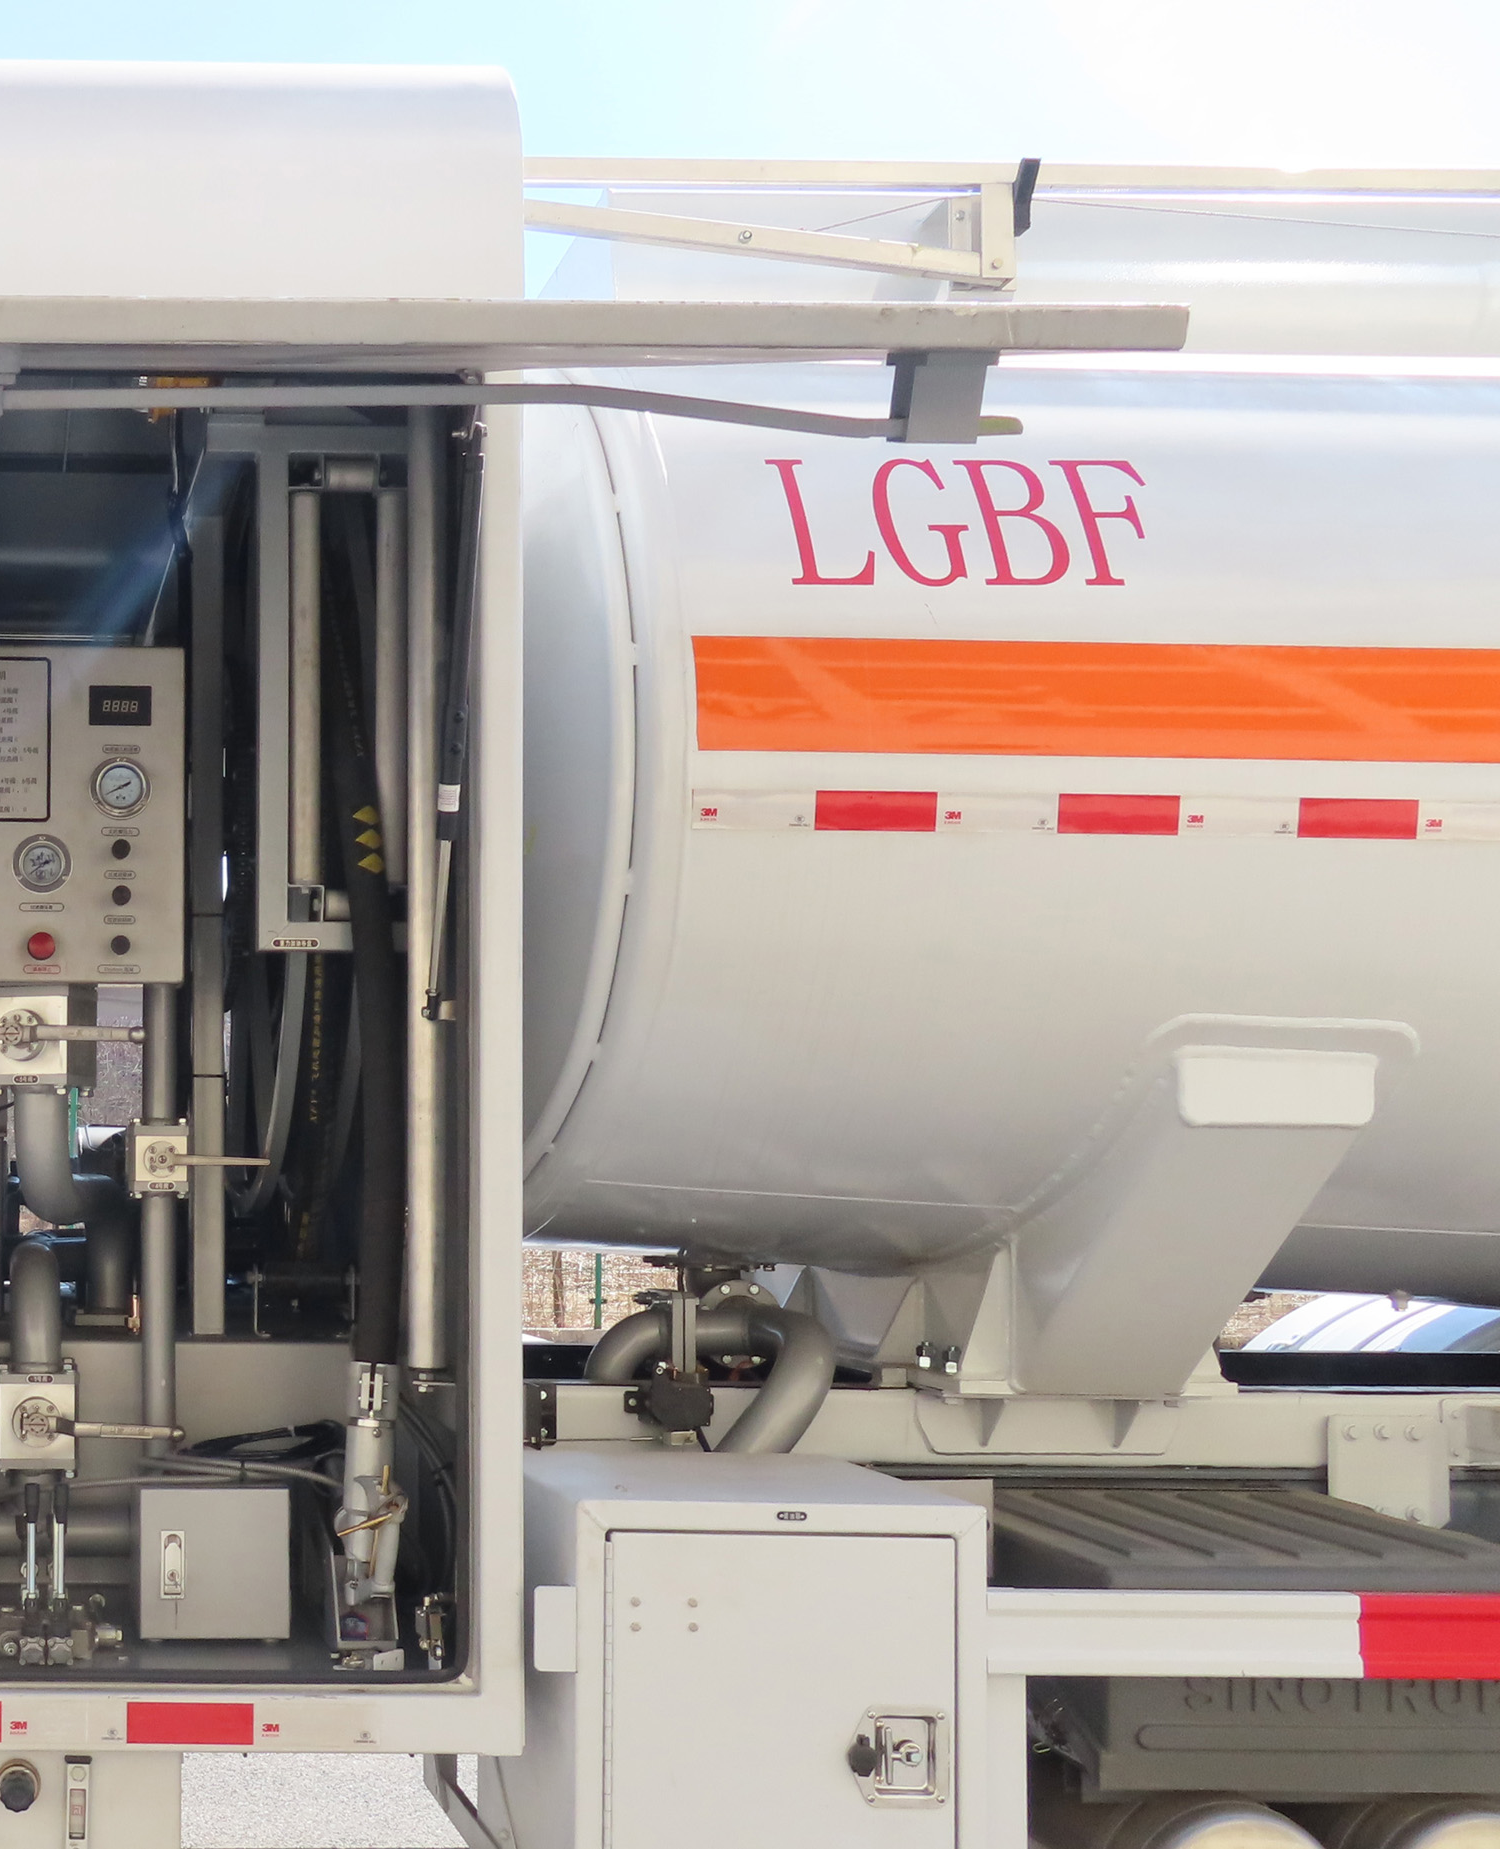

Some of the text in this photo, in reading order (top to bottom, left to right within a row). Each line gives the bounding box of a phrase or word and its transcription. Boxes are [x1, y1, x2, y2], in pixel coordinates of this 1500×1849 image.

[765, 457, 1147, 588] LGBF
[701, 807, 718, 817] 3M
[945, 810, 961, 820] 3M
[1187, 814, 1204, 824] 3M
[1427, 819, 1442, 828] 3M
[10, 1720, 27, 1730] 3M
[262, 1723, 279, 1733] 3M
